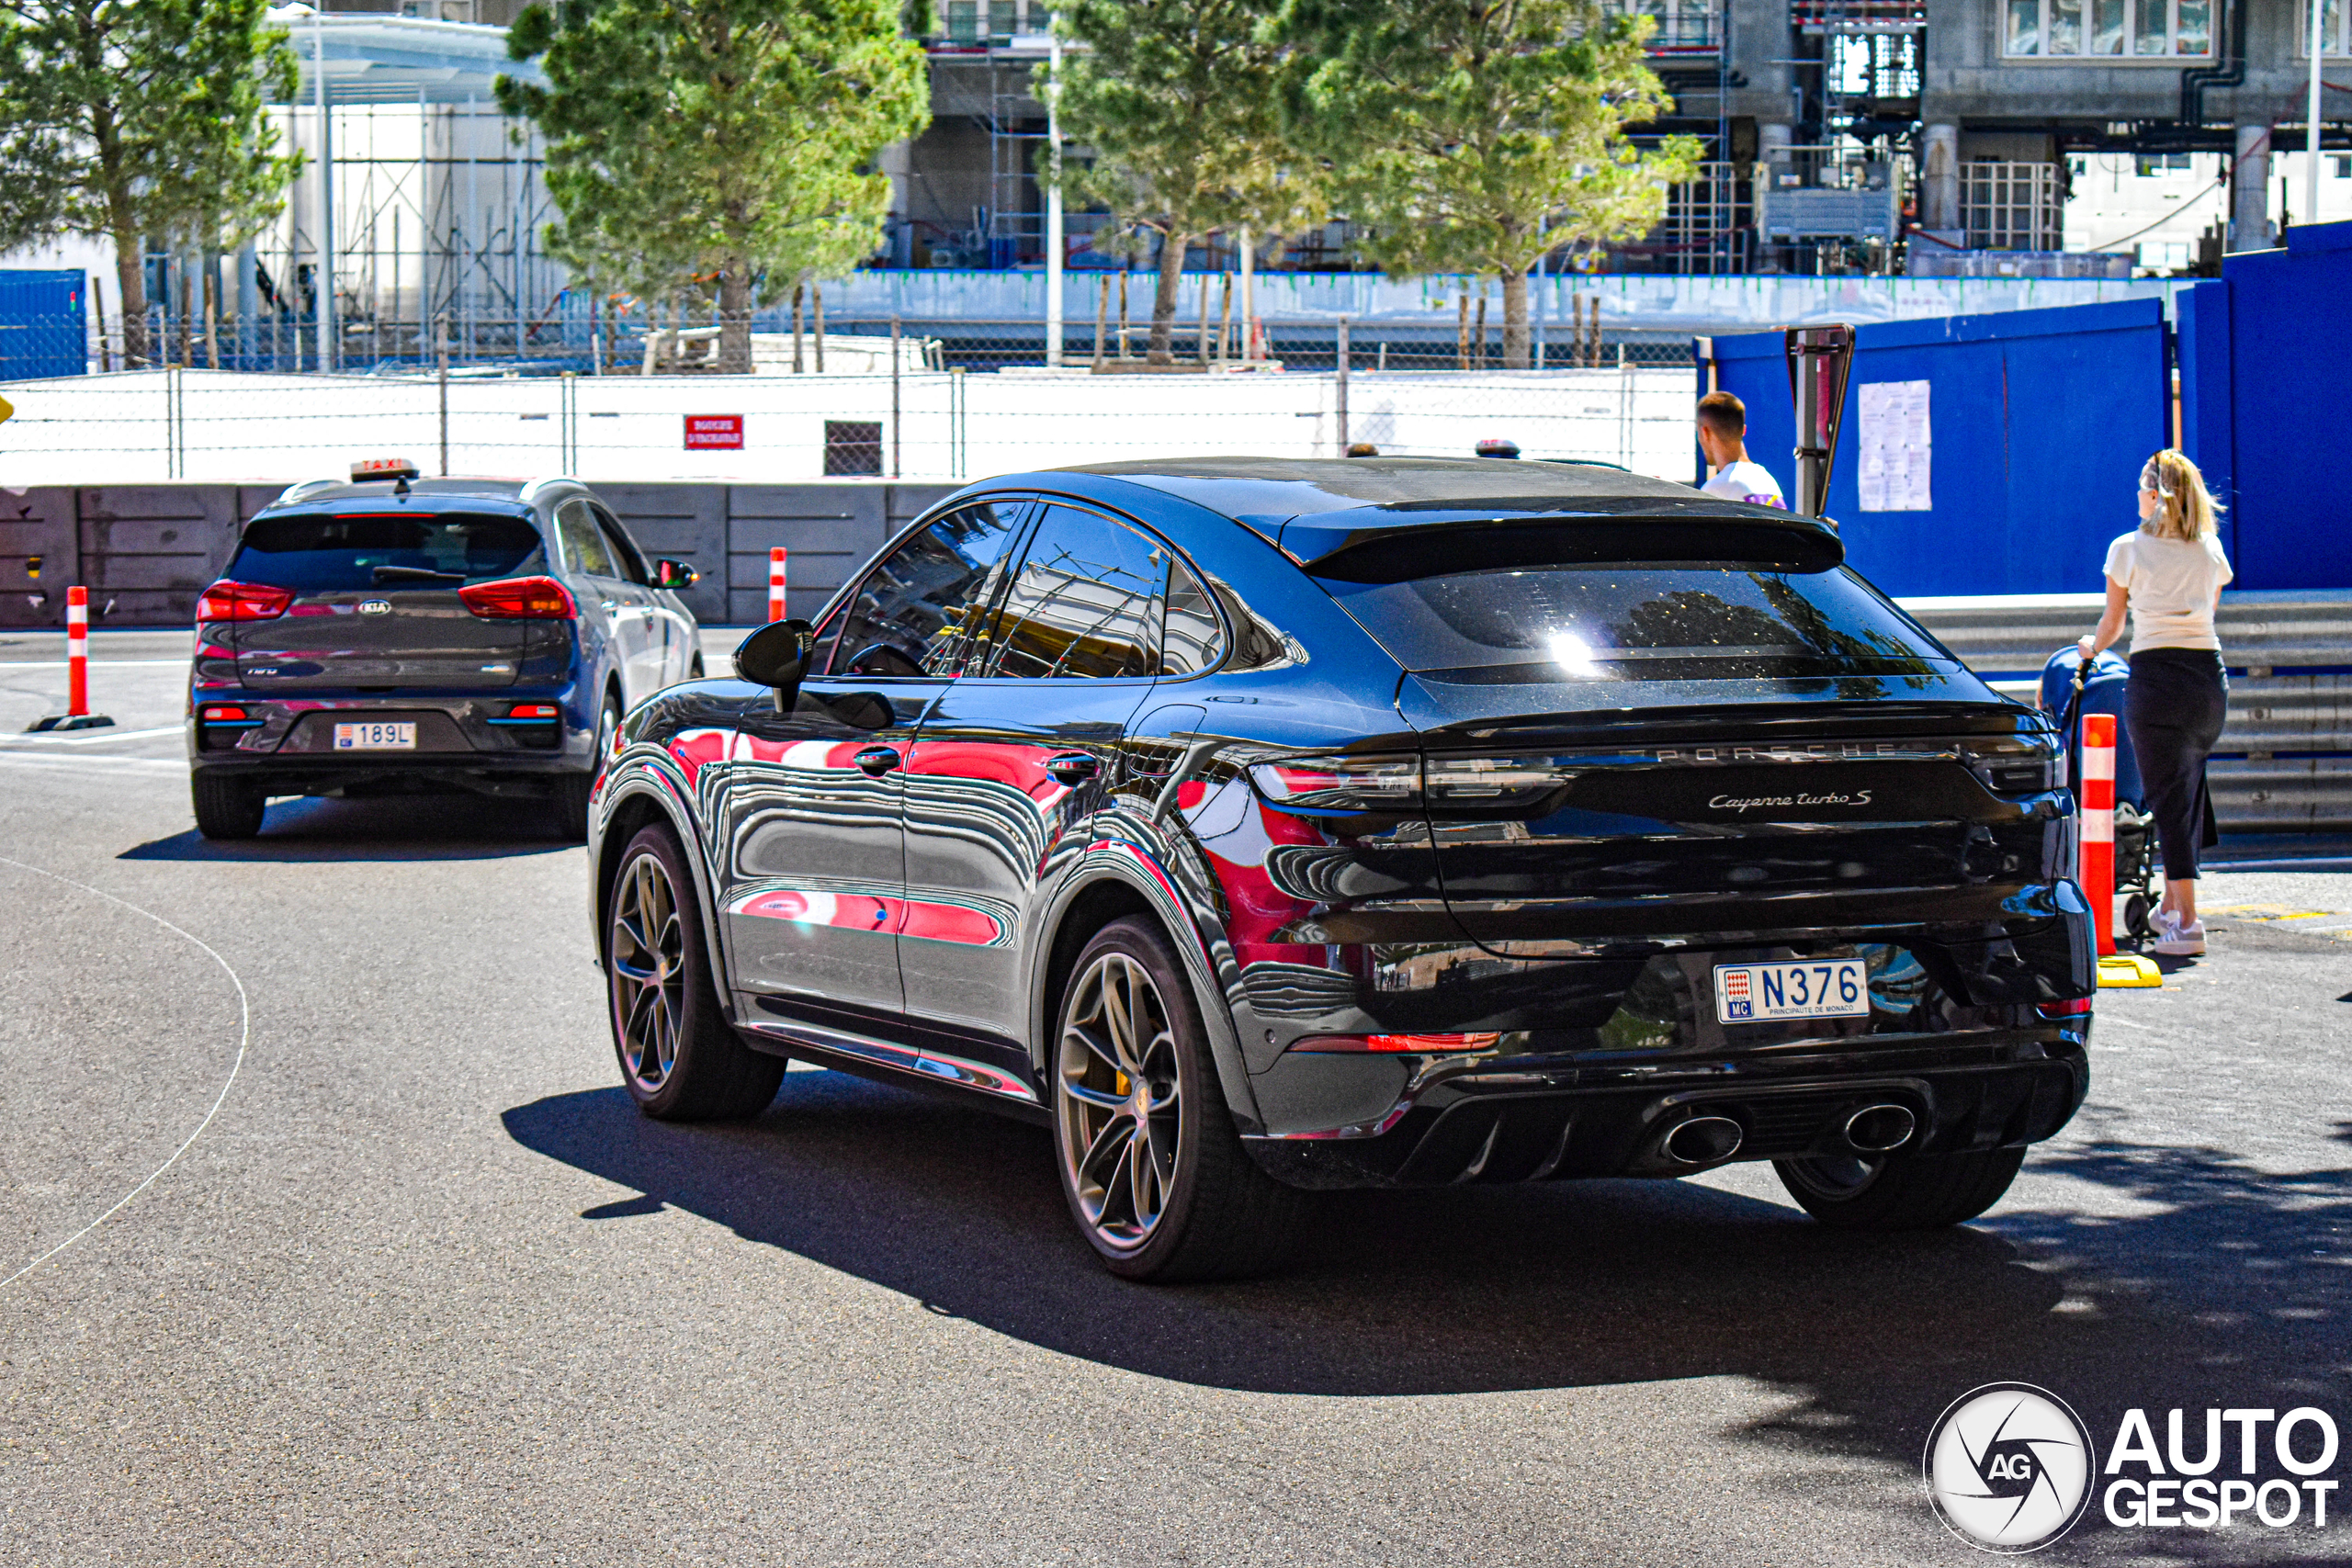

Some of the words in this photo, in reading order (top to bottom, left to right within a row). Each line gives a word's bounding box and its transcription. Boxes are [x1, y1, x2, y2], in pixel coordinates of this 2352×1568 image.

[362, 458, 402, 470] TAXI
[364, 603, 387, 613] KIA
[360, 725, 410, 743] 189L
[1657, 744, 1897, 762] PORSCHE
[1709, 795, 1793, 814] Cayenne
[1849, 789, 1872, 806] S
[1762, 965, 1859, 1008] N376
[1732, 1002, 1748, 1015] MC
